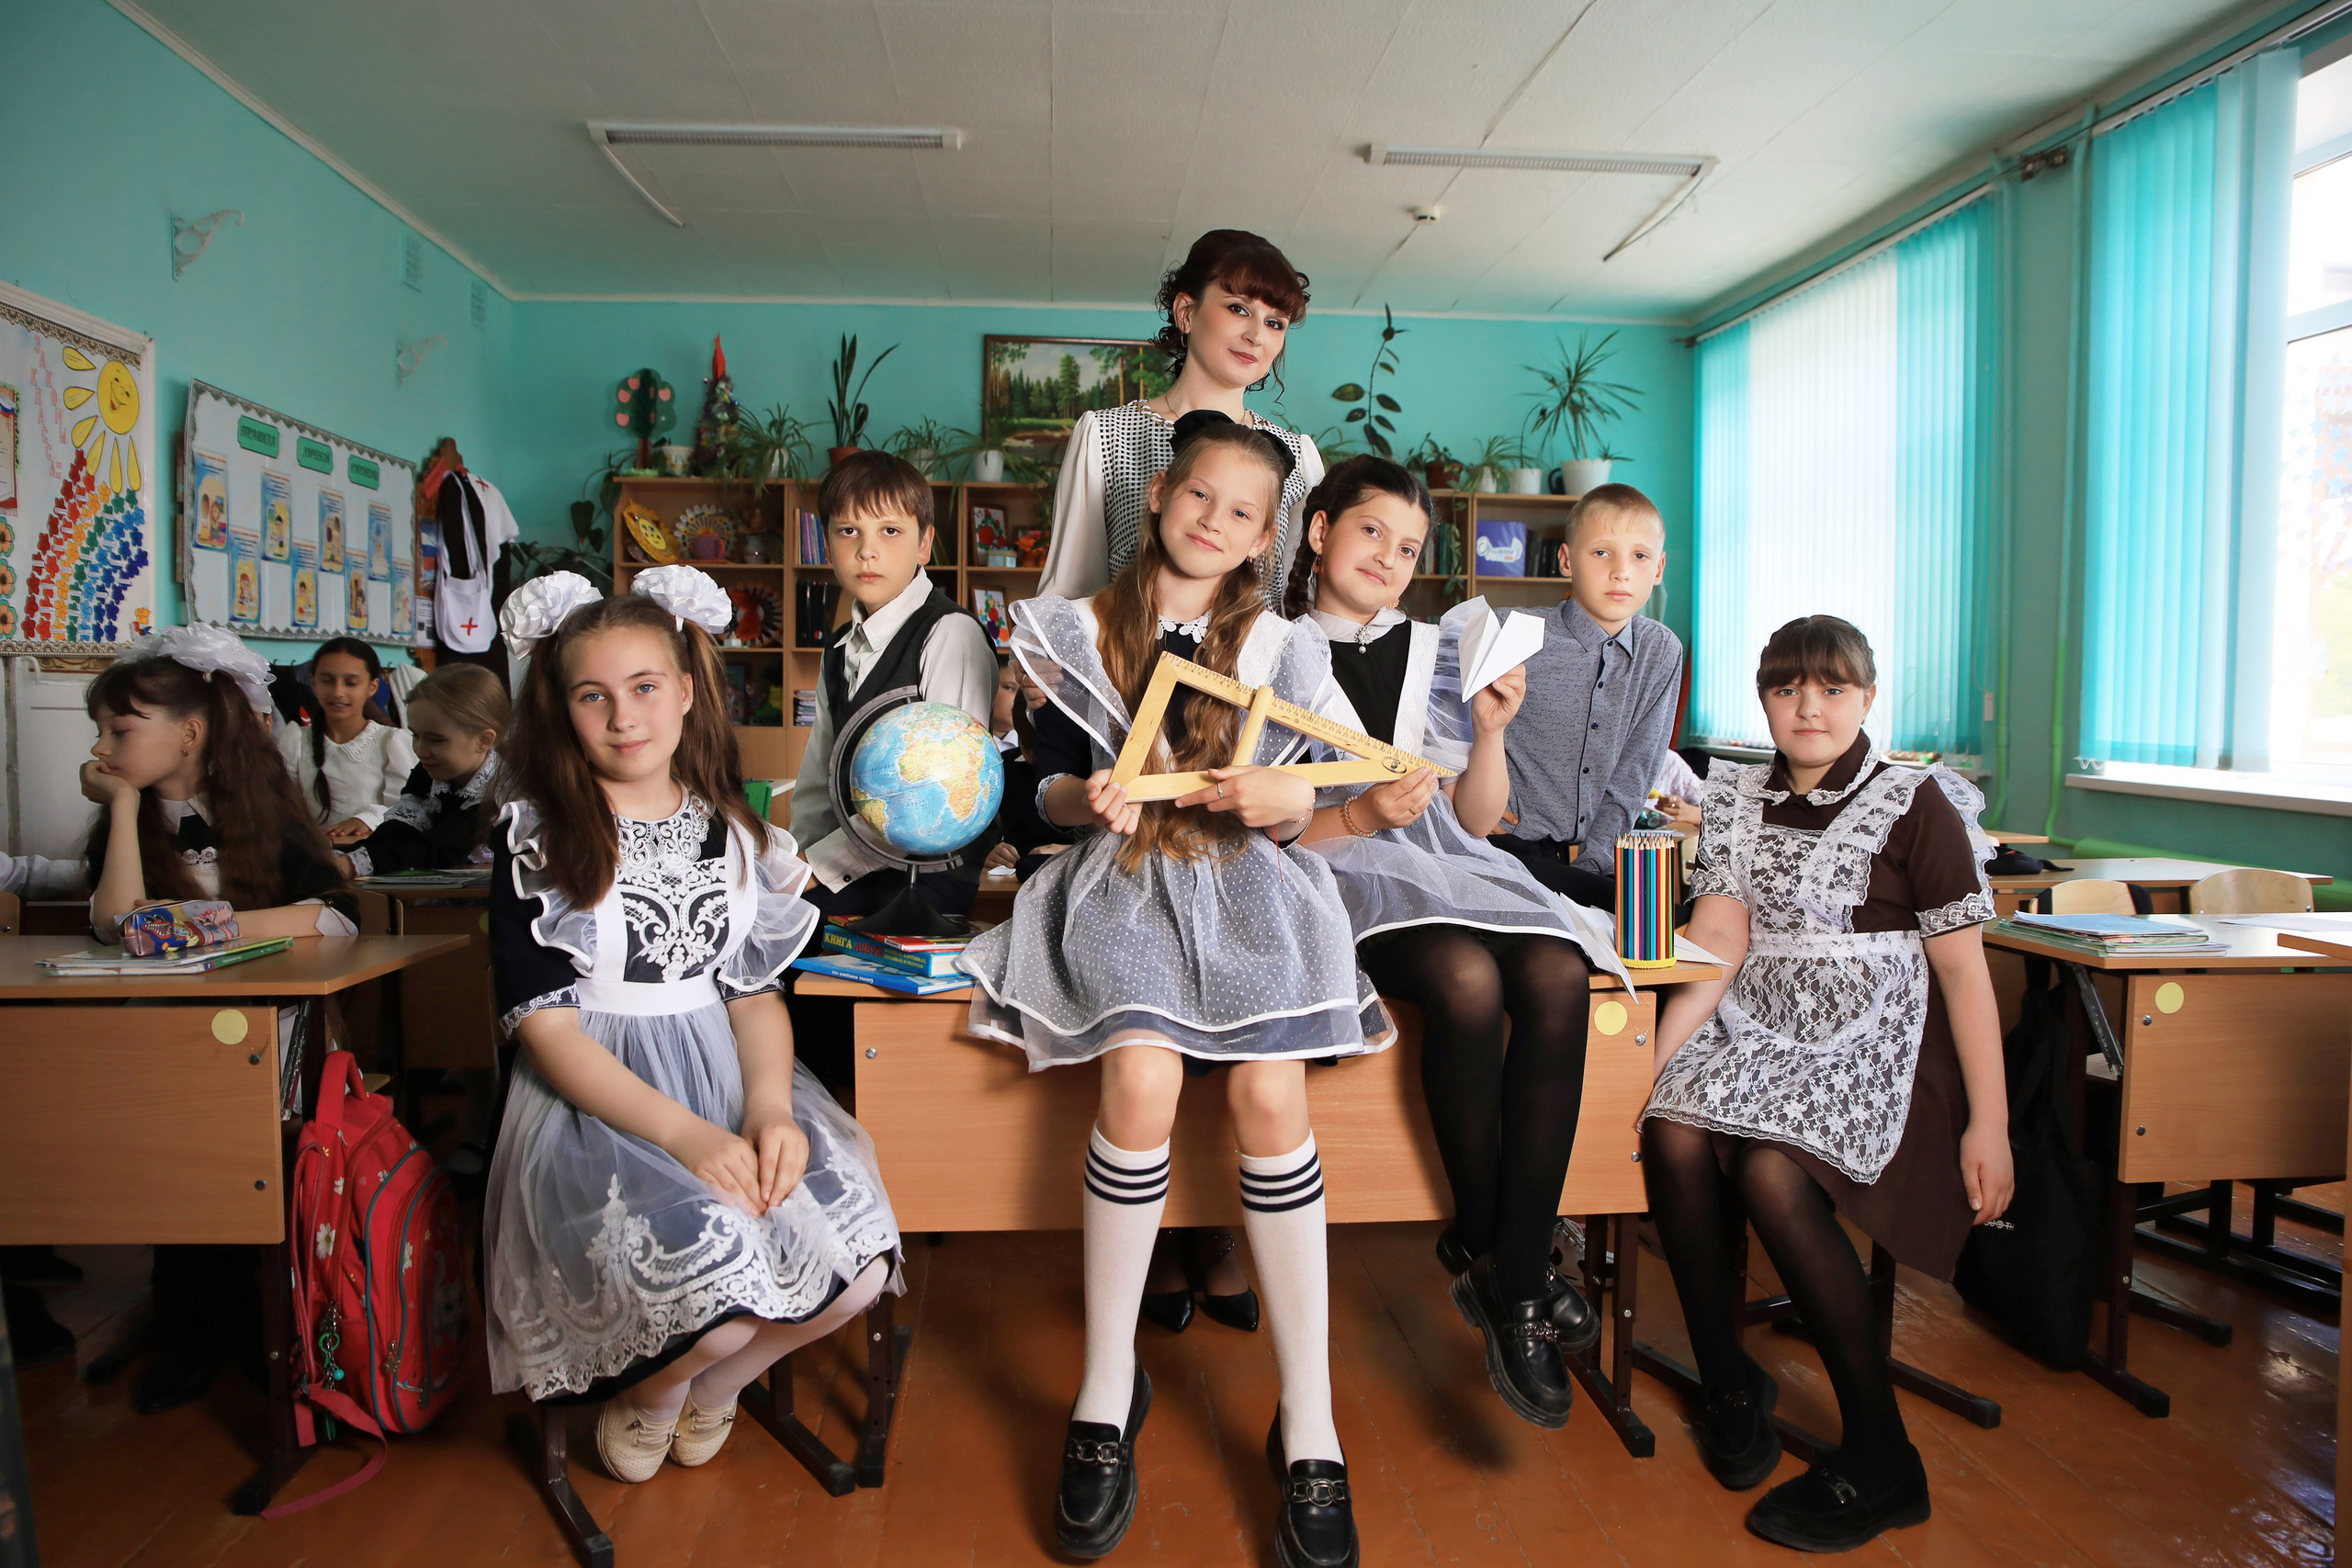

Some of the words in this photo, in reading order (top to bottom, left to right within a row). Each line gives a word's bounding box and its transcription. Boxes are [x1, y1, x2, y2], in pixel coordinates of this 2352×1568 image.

[34, 334, 67, 445] ЗАКОНЫ
[824, 932, 853, 949] КНИГА
[854, 942, 883, 957] АЗБУК
